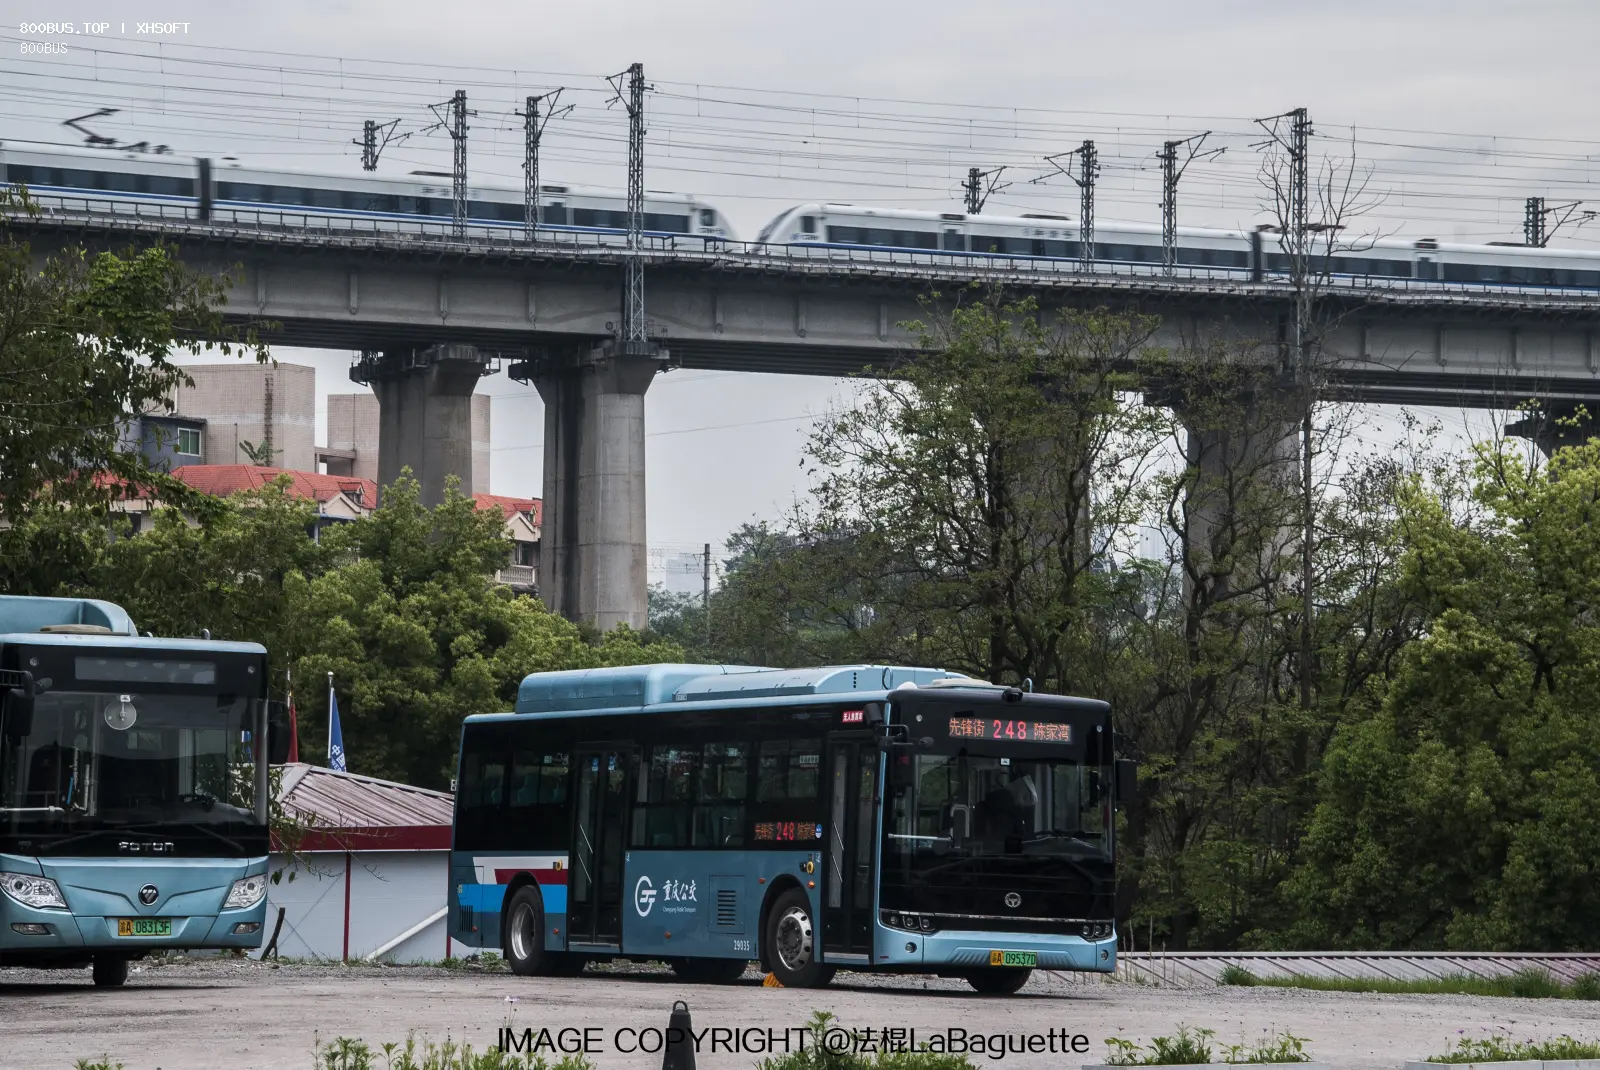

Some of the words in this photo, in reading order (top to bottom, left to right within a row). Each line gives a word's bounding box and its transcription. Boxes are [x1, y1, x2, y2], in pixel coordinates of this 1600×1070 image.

[949, 718, 985, 737] 先锋街
[993, 719, 1027, 740] 248
[1033, 722, 1070, 742] 陈家湾
[776, 822, 794, 840] 248
[118, 841, 175, 851] FOTON
[662, 879, 697, 902] 重庆公交
[733, 939, 750, 951] 29035
